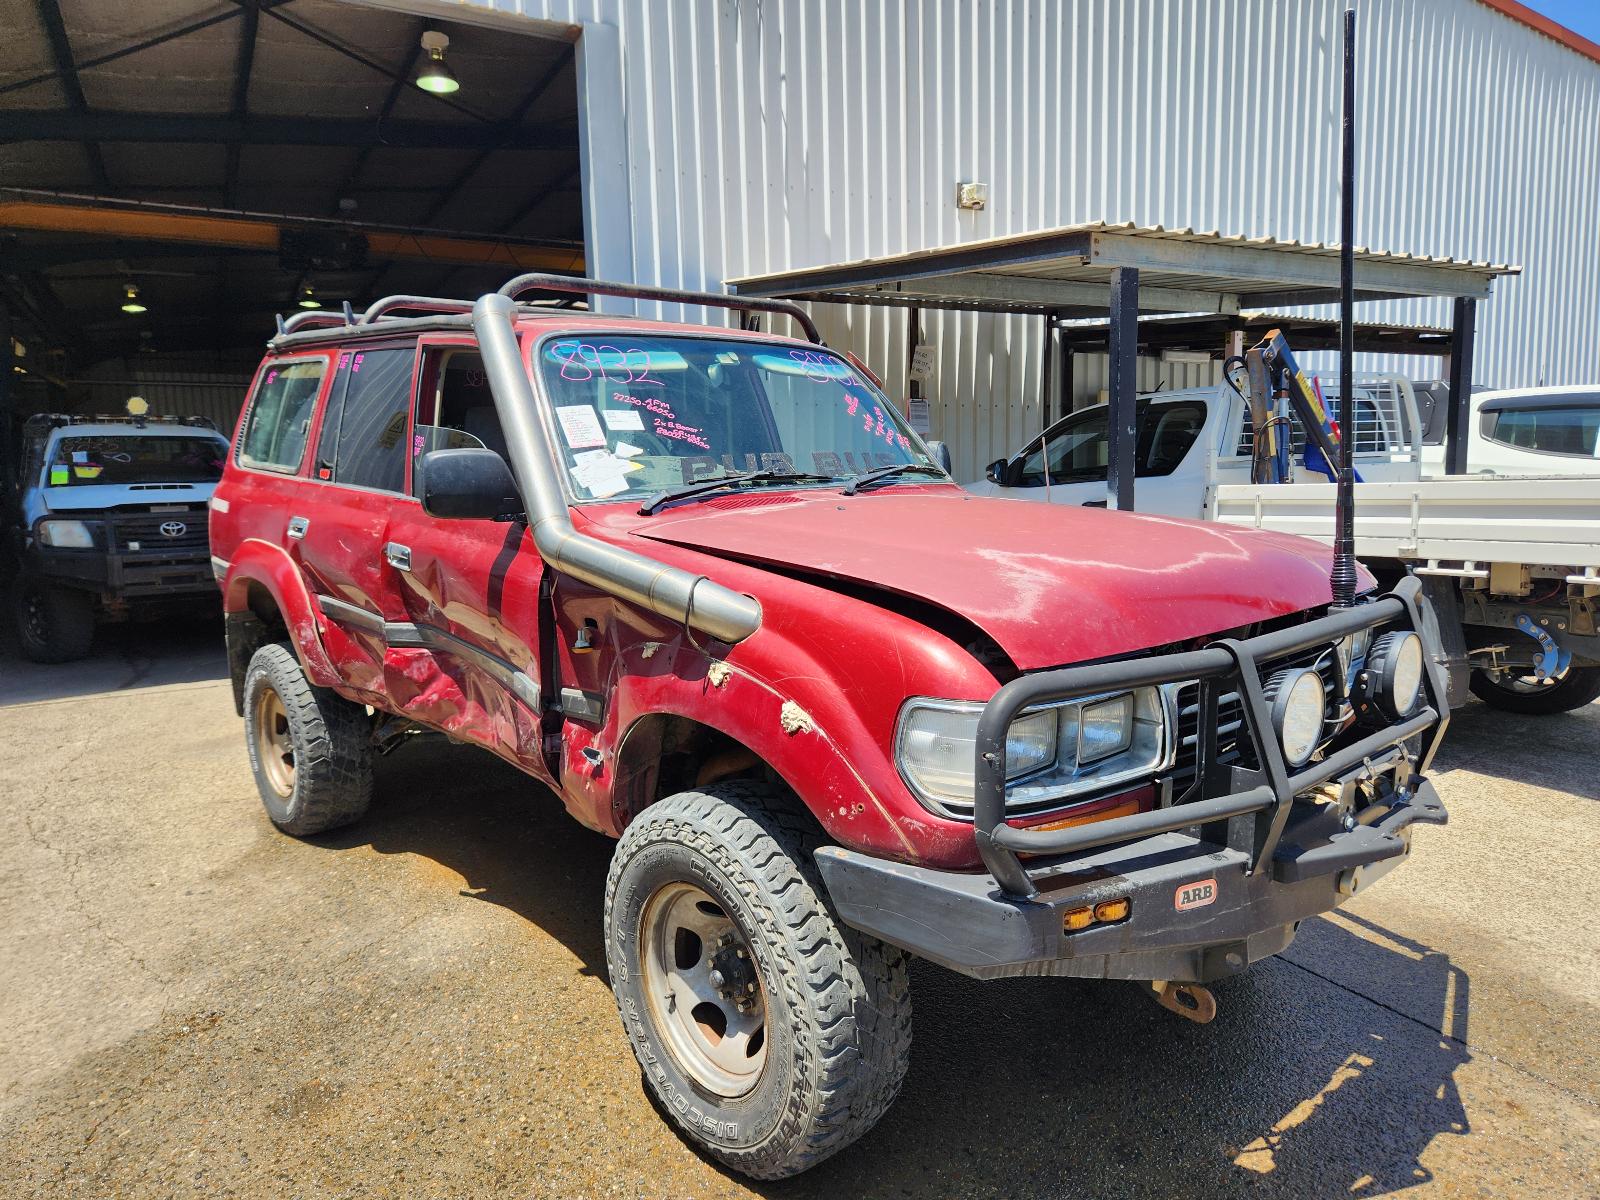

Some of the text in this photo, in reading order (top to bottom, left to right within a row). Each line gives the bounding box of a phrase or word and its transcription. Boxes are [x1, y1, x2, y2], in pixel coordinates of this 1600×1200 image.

[551, 343, 665, 386] 8932
[1181, 884, 1213, 906] ARB
[690, 857, 778, 997] COOPER
